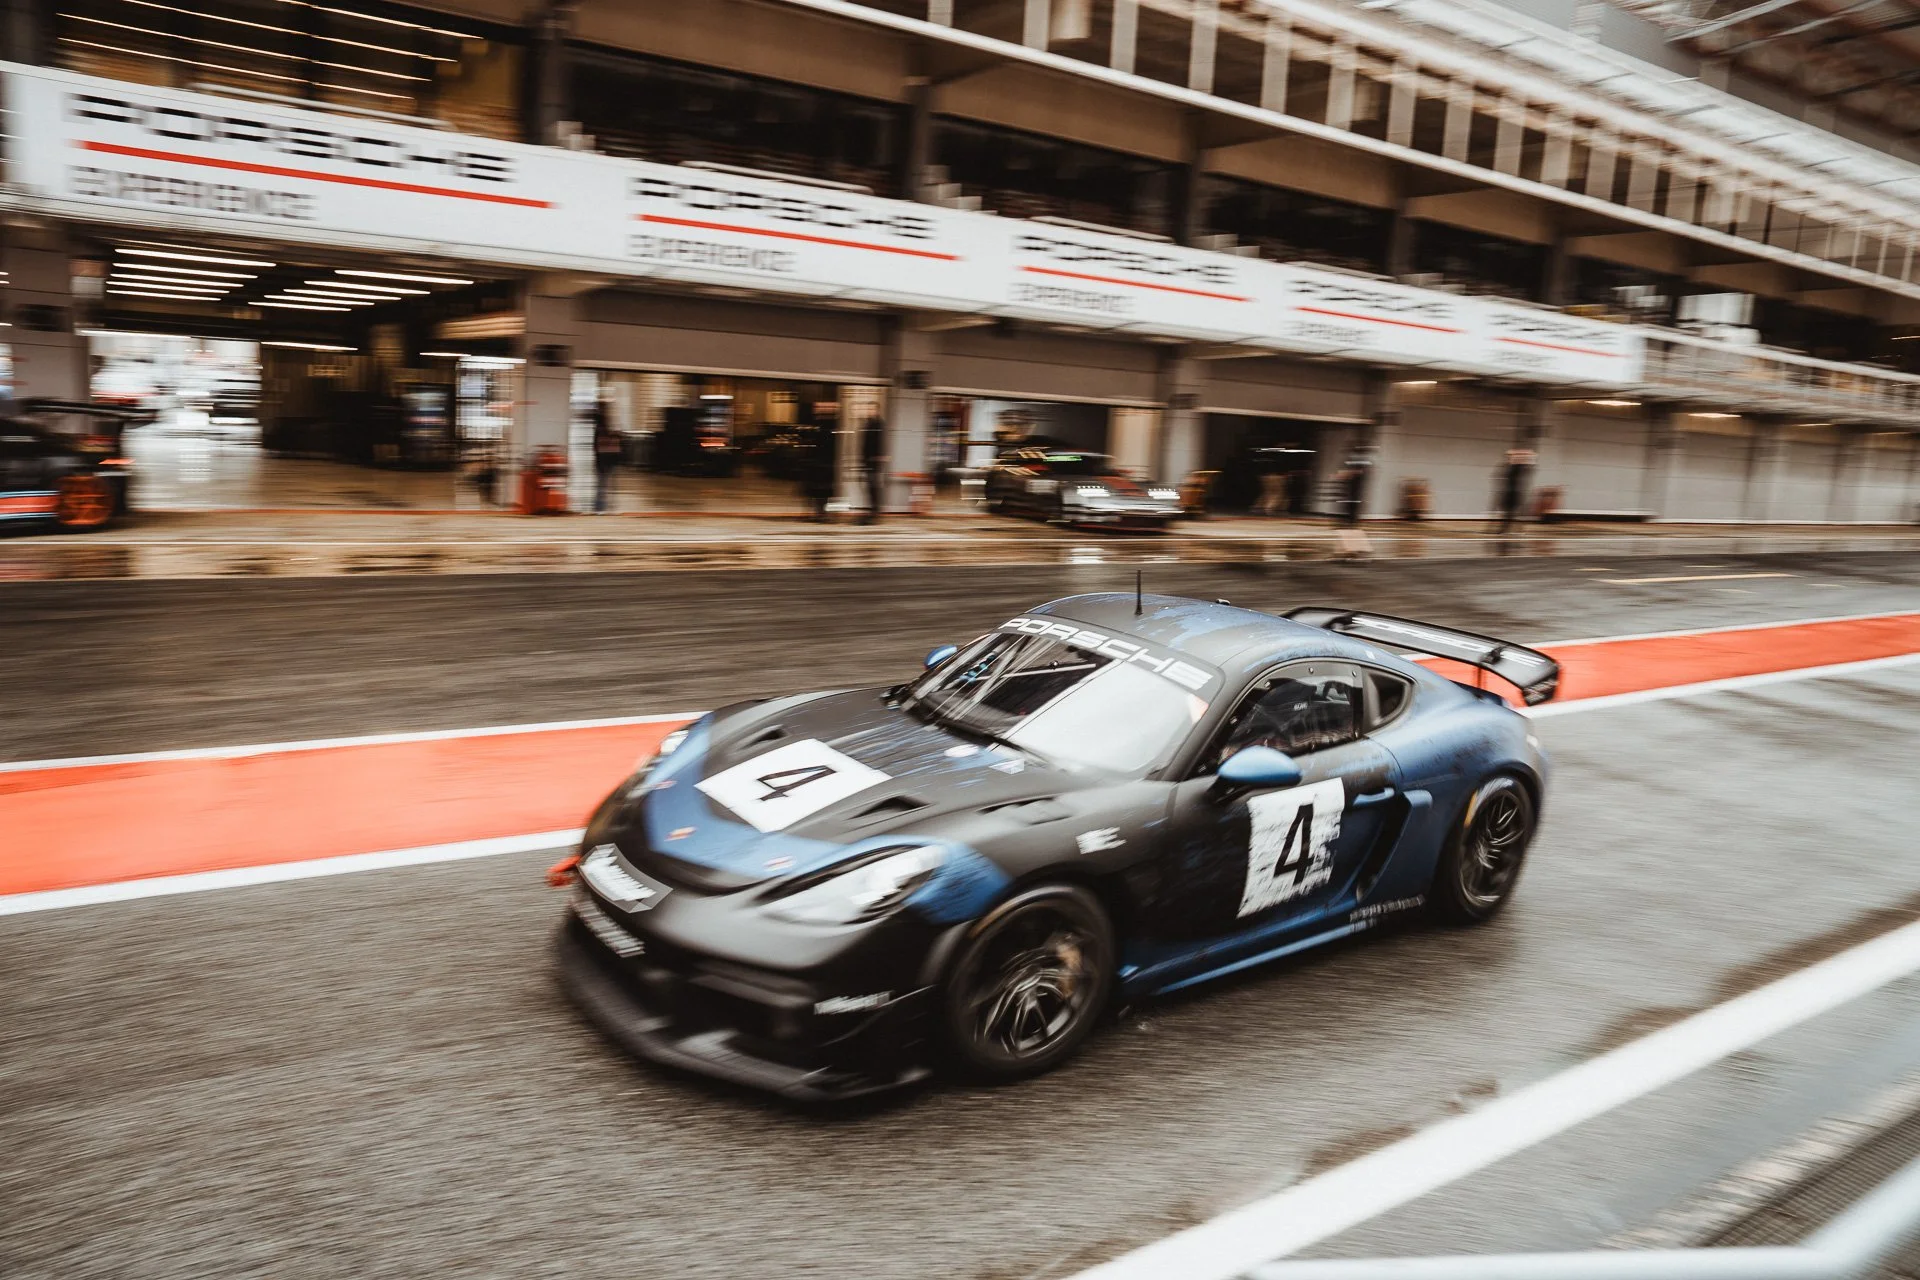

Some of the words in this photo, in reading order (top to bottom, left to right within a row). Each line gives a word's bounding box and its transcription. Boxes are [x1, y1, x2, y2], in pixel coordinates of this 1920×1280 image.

[70, 92, 514, 182] PORSCHE
[632, 177, 936, 239] PORSCHE
[998, 618, 1214, 691] PORSCHE
[757, 764, 837, 802] 4
[1273, 803, 1315, 886] 4
